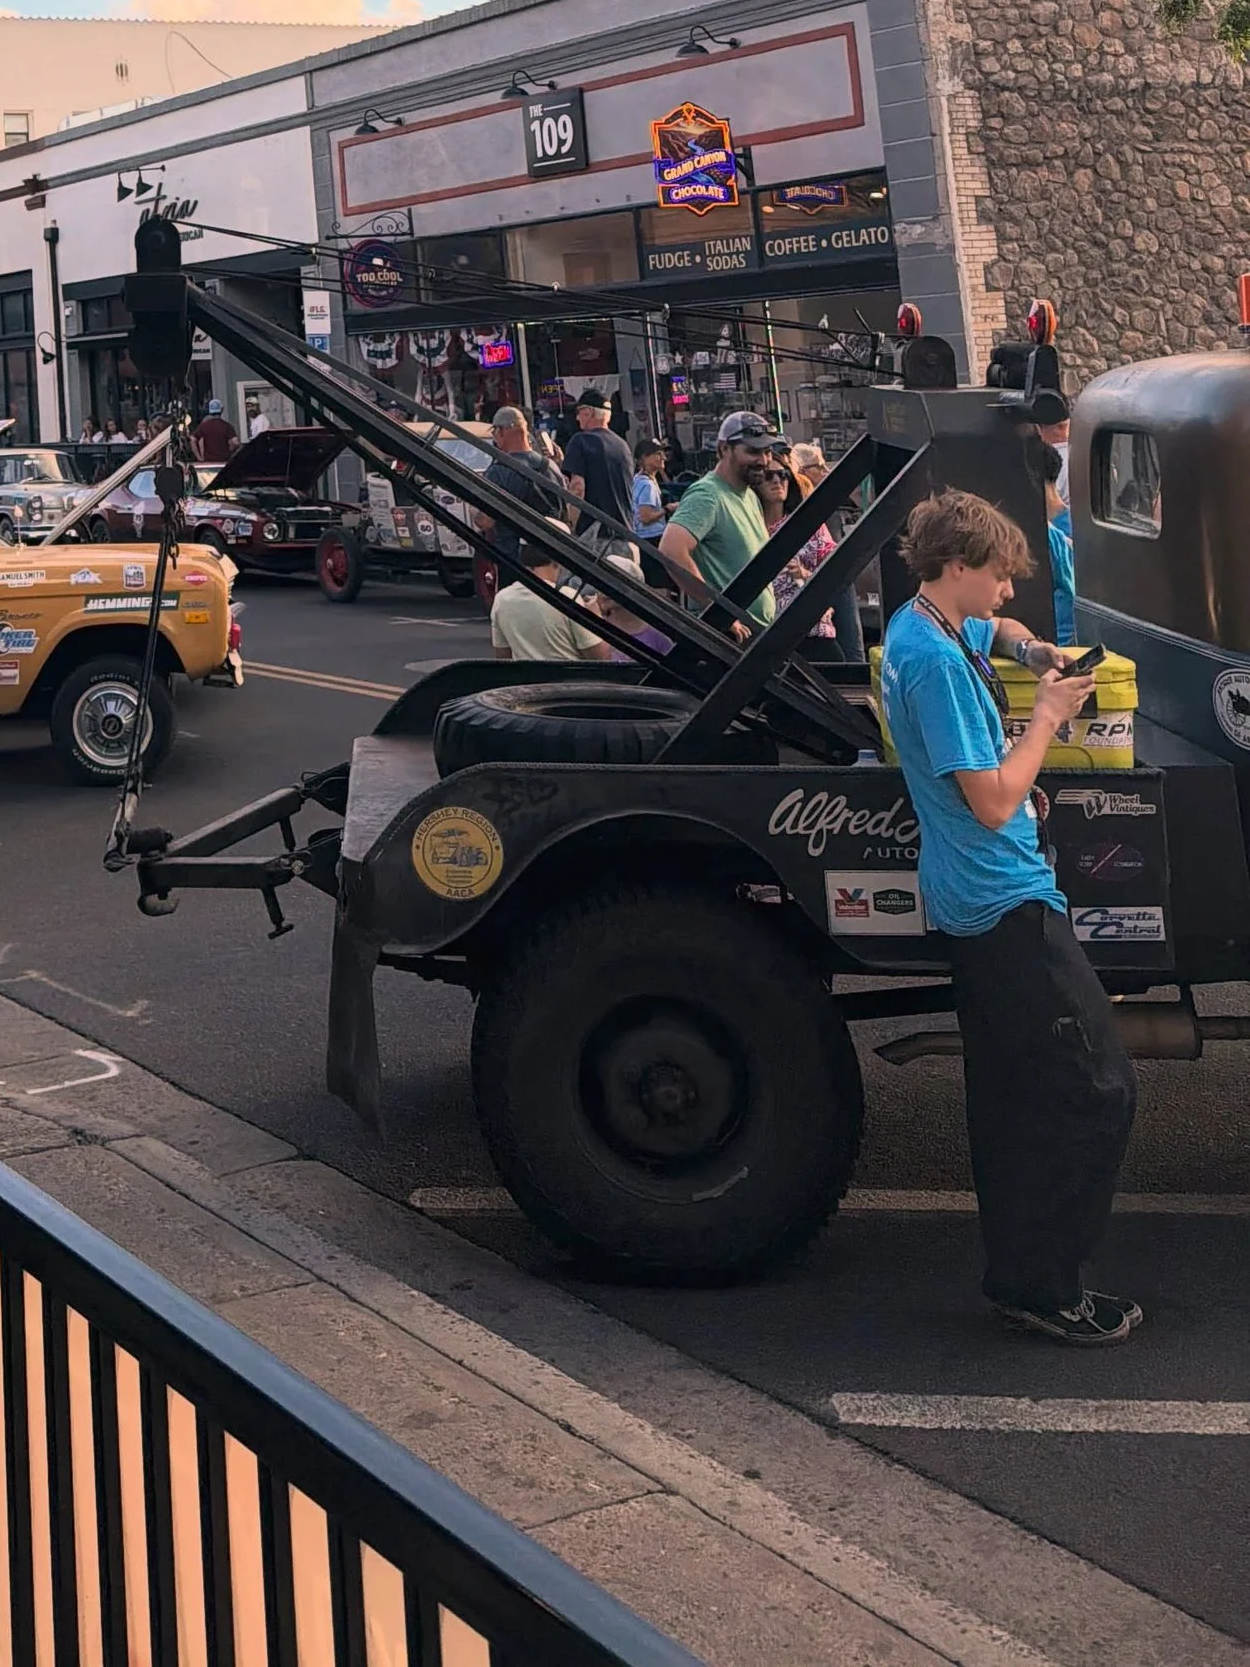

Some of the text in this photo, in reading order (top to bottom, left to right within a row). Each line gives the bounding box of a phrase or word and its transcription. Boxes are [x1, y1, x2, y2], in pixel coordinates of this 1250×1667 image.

[529, 103, 544, 119] THE
[530, 114, 574, 158] 109
[663, 151, 727, 181] GRAND CANYON
[672, 185, 725, 201] CHOCOLATE
[705, 236, 751, 257] ITALIAN
[764, 226, 890, 258] COFFEE GELATO
[649, 250, 692, 271] FUDGE
[706, 253, 747, 272] SODAS
[355, 272, 376, 283] TOO
[1109, 793, 1140, 805] Wheel
[1110, 803, 1155, 815] Vintiques
[416, 808, 499, 842] HERSHEY REGION
[445, 888, 476, 898] AACA
